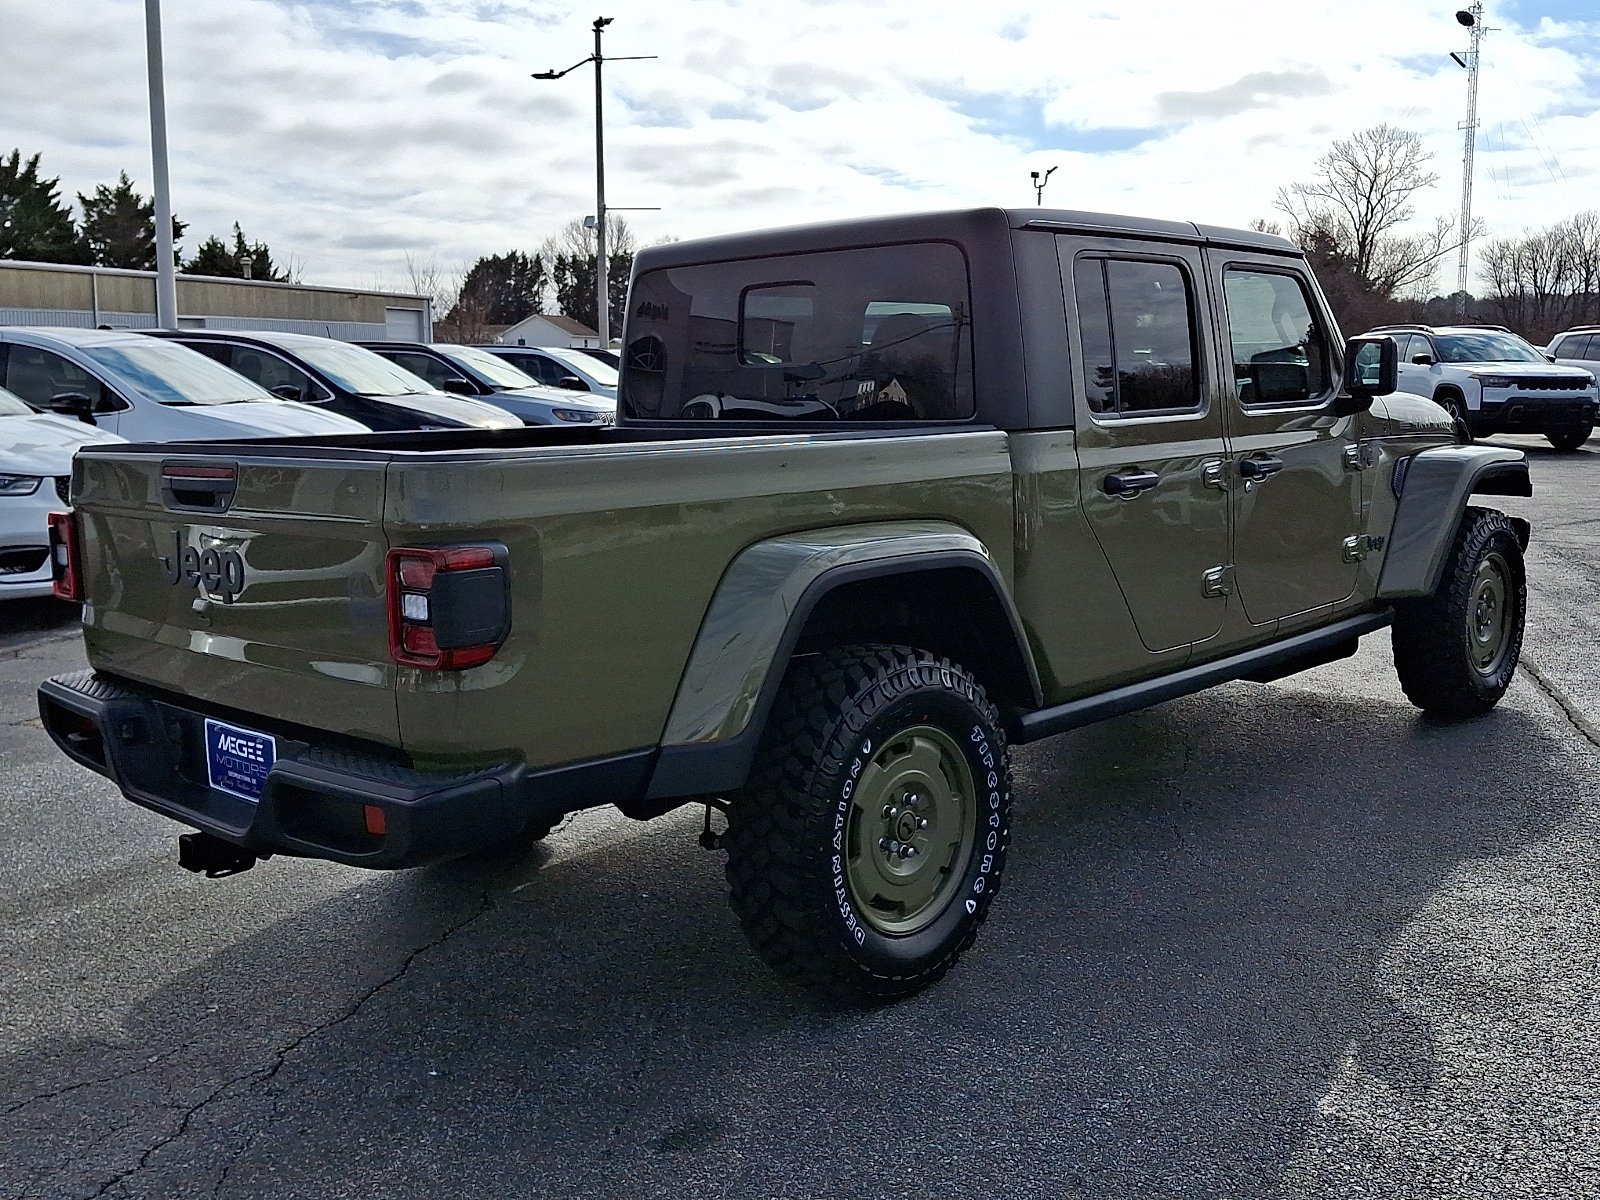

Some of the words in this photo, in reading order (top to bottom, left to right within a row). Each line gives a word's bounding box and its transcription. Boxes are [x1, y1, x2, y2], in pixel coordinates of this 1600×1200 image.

[159, 530, 245, 604] Jeep
[216, 753, 268, 779] MOTORS
[218, 734, 265, 762] MEGEE
[833, 757, 865, 946] DESTINATION
